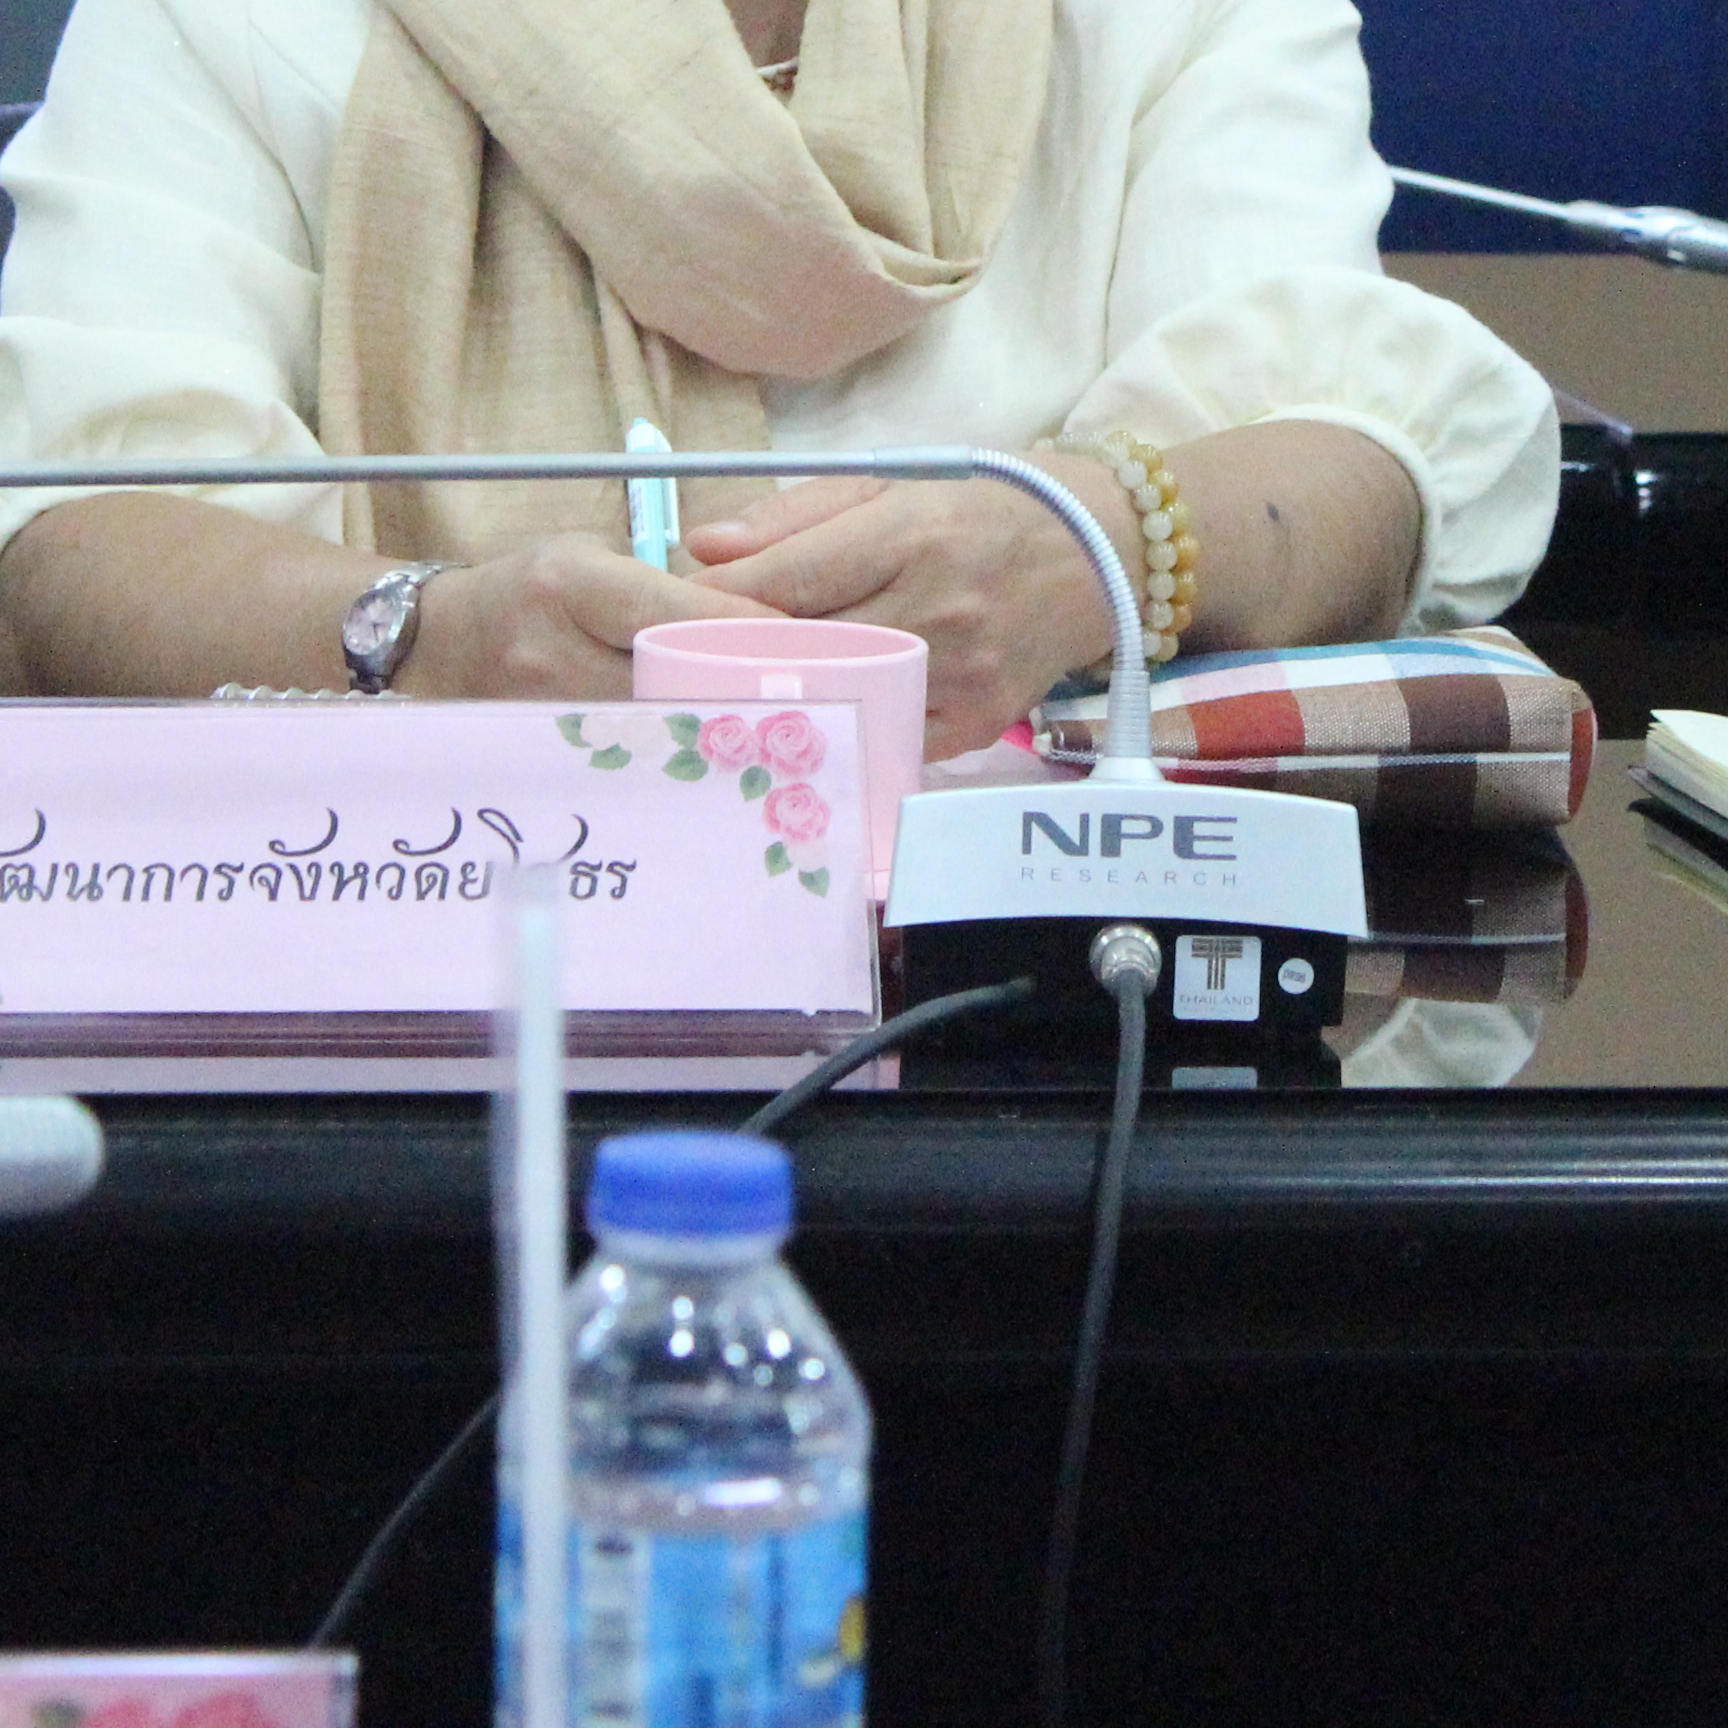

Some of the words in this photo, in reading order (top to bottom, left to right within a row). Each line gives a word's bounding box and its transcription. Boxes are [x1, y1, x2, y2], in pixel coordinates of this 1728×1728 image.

[1022, 811, 1238, 860] NPE
[1021, 867, 1237, 886] RESEARCH
[1179, 995, 1253, 1006] THAILAND
